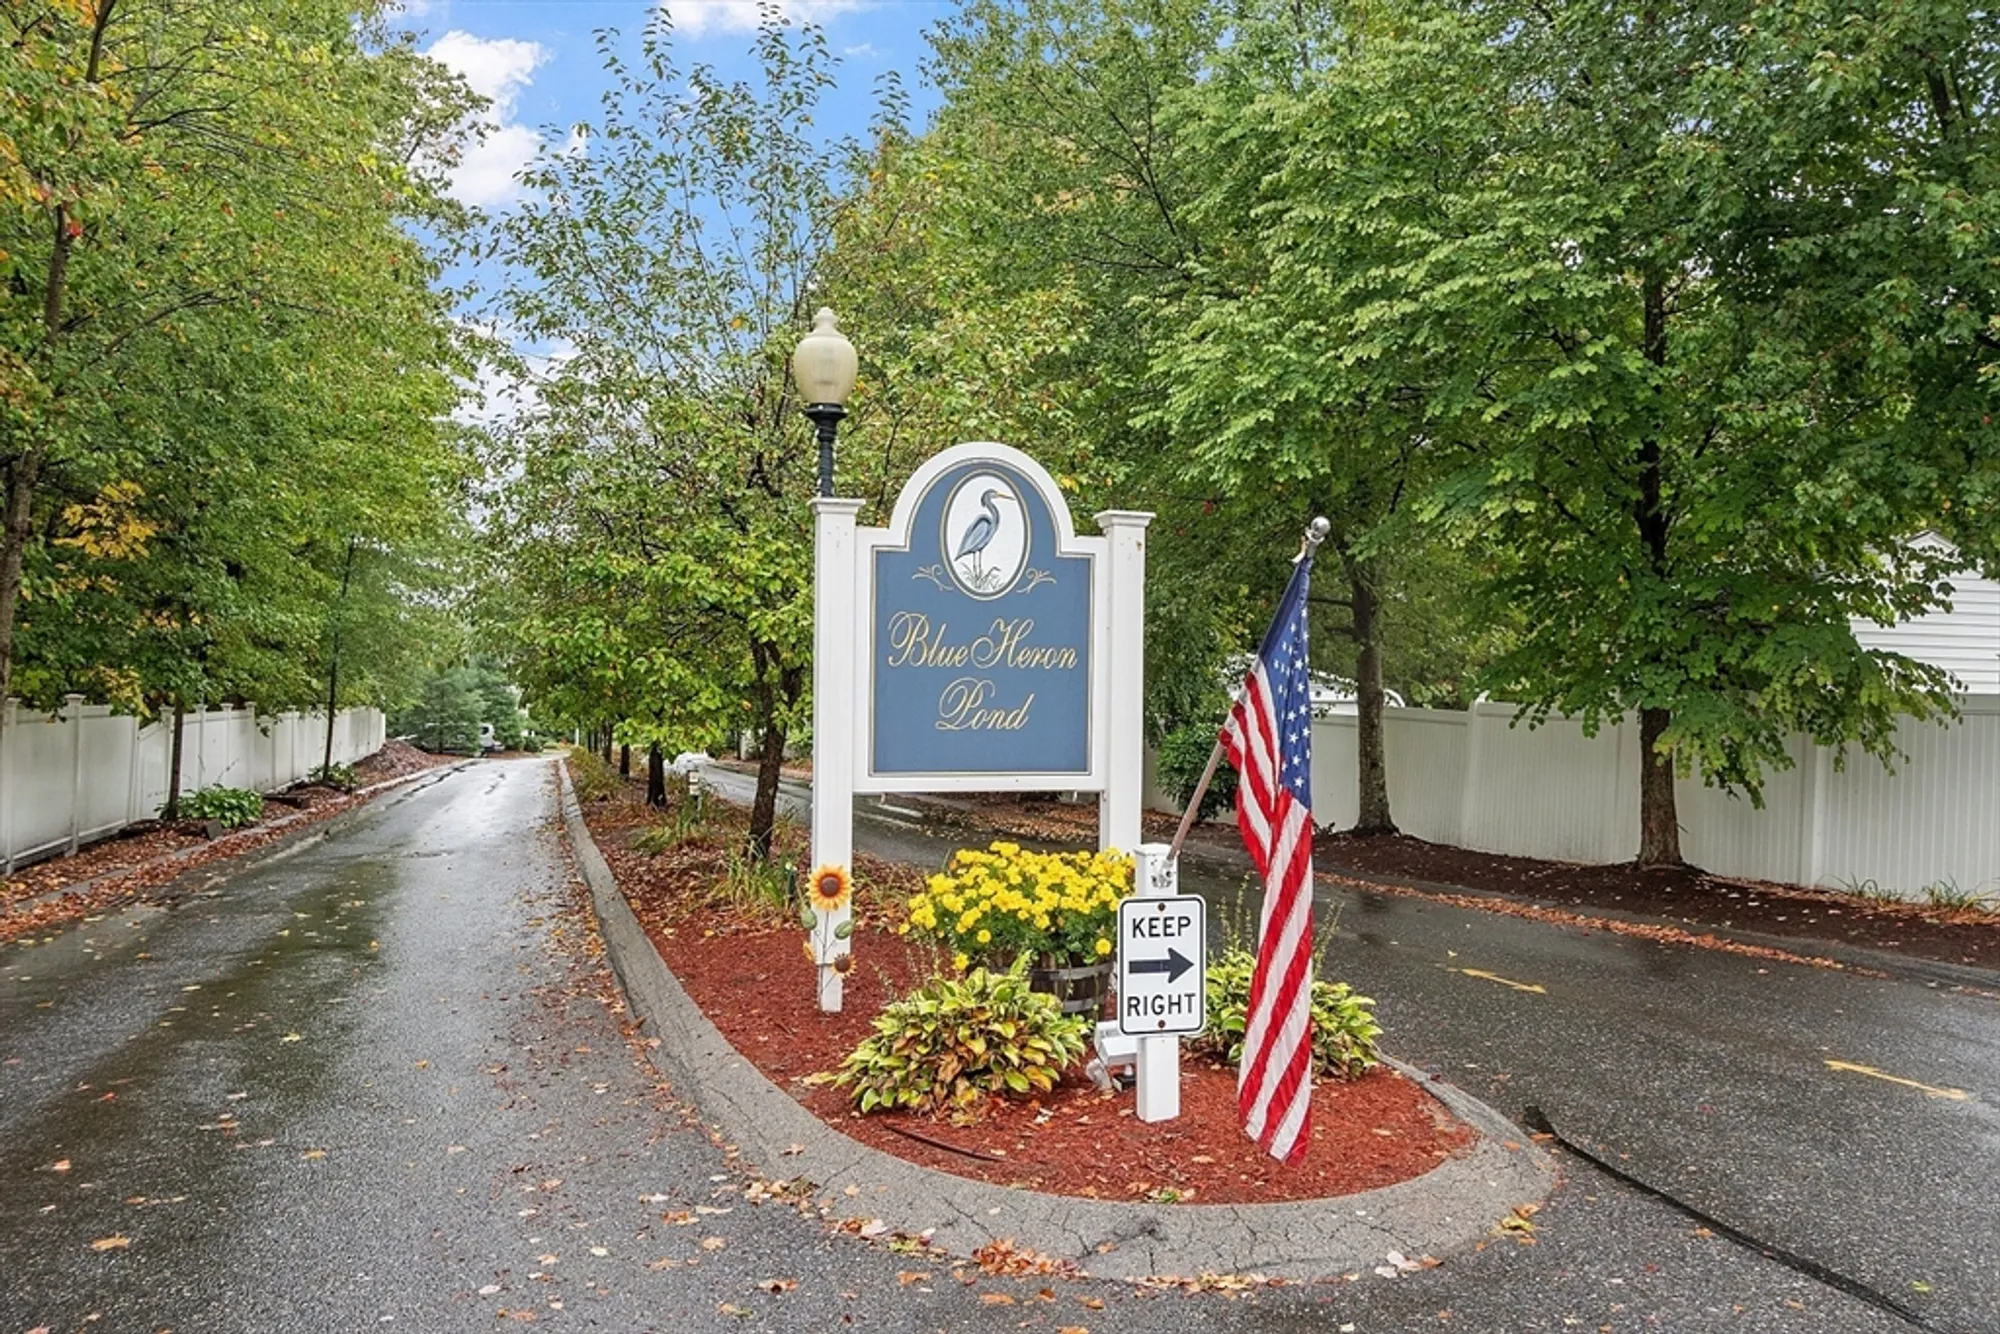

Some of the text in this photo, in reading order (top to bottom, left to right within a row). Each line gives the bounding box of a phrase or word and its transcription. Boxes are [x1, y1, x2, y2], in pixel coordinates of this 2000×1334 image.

[887, 611, 1078, 670] Blue Heron
[935, 677, 1034, 731] Pond
[1132, 916, 1191, 938] KEEP
[1127, 993, 1196, 1017] RIGHT
